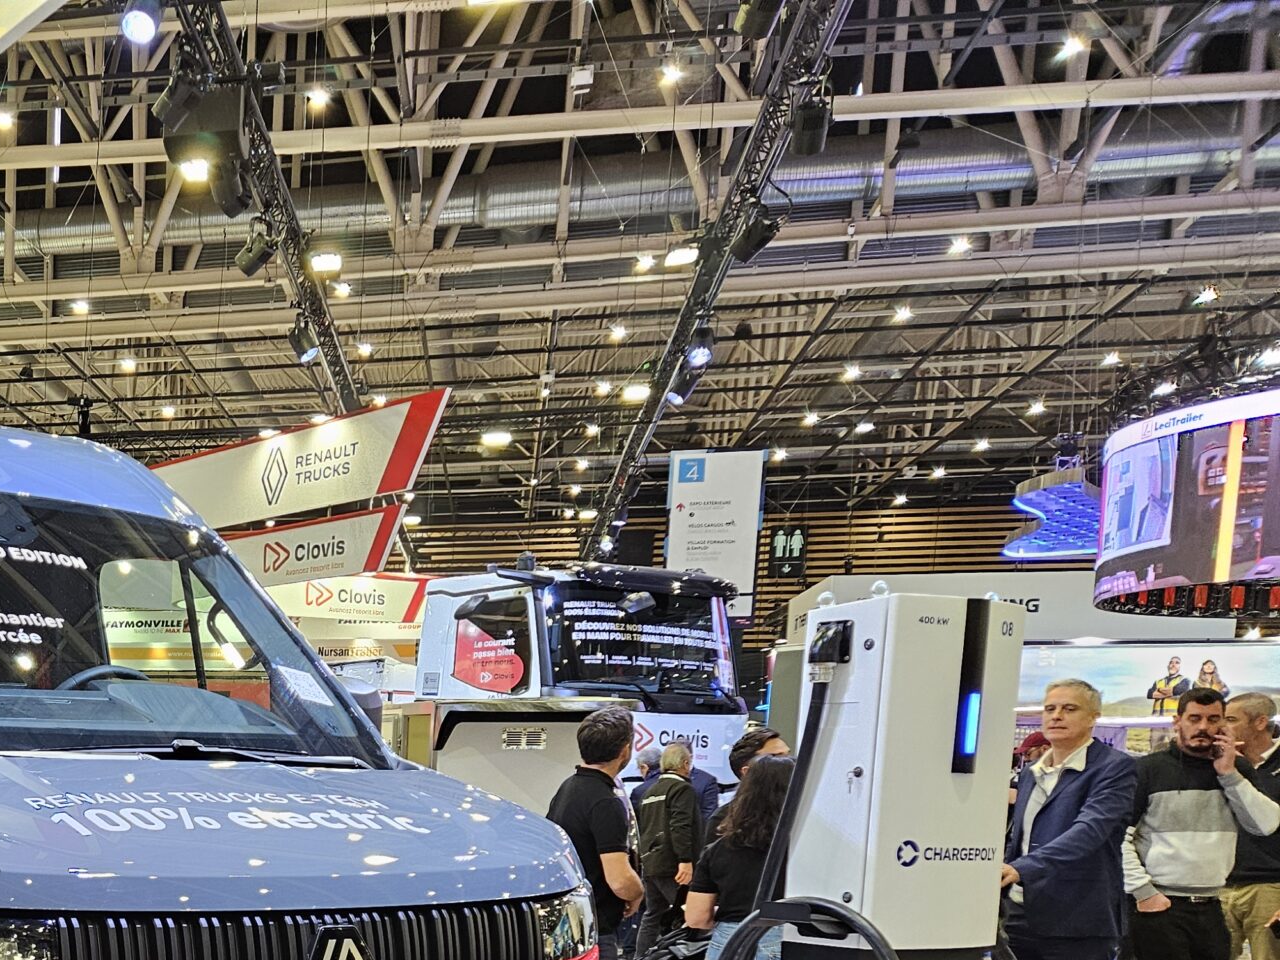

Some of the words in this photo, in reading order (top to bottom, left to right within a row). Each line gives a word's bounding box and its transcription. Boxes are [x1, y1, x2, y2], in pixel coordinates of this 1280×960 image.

[1155, 413, 1203, 430] LeciTrailer
[295, 442, 359, 468] RENAULT
[295, 462, 350, 485] TRUCKS
[686, 464, 699, 480] 4
[294, 536, 345, 561] Clovis
[8, 546, 88, 570] EDITION
[338, 589, 385, 605] Clovis
[584, 606, 624, 617] ÉLECTRIQU
[106, 620, 182, 629] FAYMONVILLE
[574, 620, 625, 631] DÉCOUVREZ
[626, 624, 642, 632] NOS
[918, 616, 934, 624] 400
[937, 617, 950, 625] kW
[1001, 621, 1013, 636] 08
[483, 638, 515, 647] courant
[572, 632, 585, 640] EN
[586, 632, 609, 640] MAIN
[610, 633, 632, 641] POUR
[473, 651, 495, 659] passe
[497, 648, 515, 656] bien
[24, 792, 167, 810] RENAULT
[168, 792, 289, 804] TRUCKS
[288, 793, 390, 810] E-TECH
[50, 807, 222, 836] 100%
[227, 806, 432, 834] electric
[923, 847, 997, 861] CHARGEPOLY
